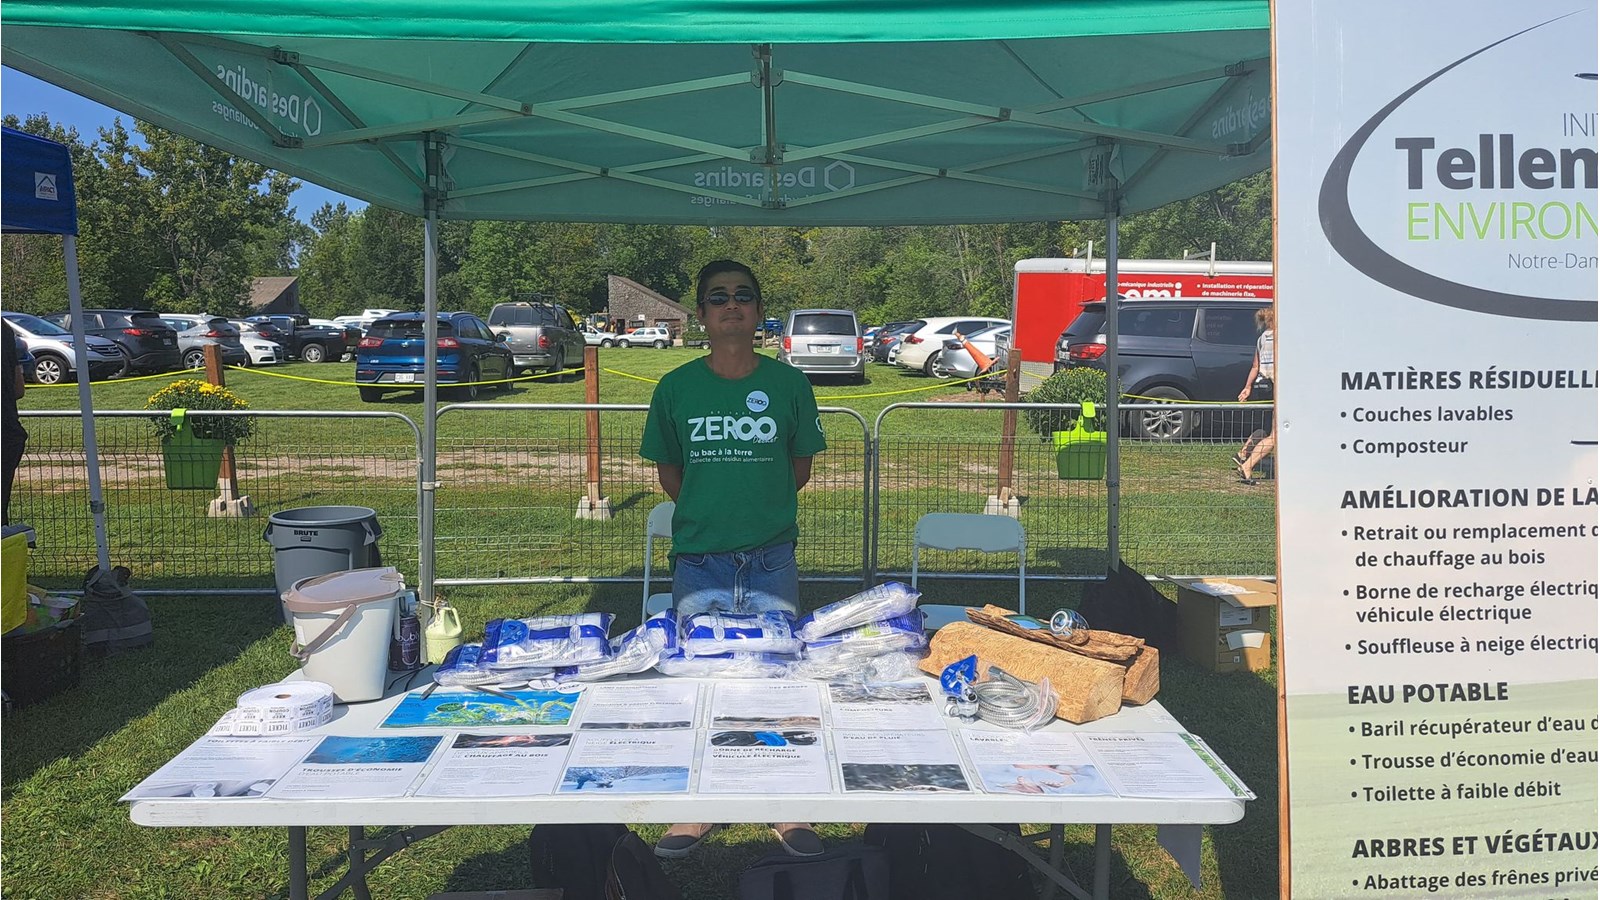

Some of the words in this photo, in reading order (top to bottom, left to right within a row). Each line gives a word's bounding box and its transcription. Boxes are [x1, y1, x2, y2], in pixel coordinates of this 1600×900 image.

[1563, 112, 1598, 137] INI
[1407, 201, 1598, 241] ENVIRON
[1341, 366, 1462, 391] MATIÈRES
[1353, 407, 1432, 422] Couches
[1437, 405, 1514, 421] lavables
[689, 450, 700, 458] Du
[718, 448, 723, 456] à
[724, 448, 732, 456] la
[734, 448, 753, 456] terre
[1353, 439, 1468, 458] Composteur
[1341, 485, 1529, 509] AMÉLIORATION
[1536, 488, 1565, 506] DE
[294, 529, 318, 537] BRUTE
[1353, 525, 1419, 541] Retrait
[1424, 527, 1448, 540] ou
[1452, 524, 1586, 543] remplacement
[1355, 551, 1378, 567] de
[1383, 550, 1476, 570] chauffage
[1481, 552, 1503, 565] au
[1508, 549, 1546, 565] bois
[1355, 584, 1411, 599] Borne
[1416, 583, 1439, 599] de
[1444, 582, 1525, 601] recharge
[1356, 606, 1434, 623] véhicule
[1439, 605, 1532, 624] électrique
[1358, 638, 1455, 655] Souffleuse
[1460, 637, 1471, 652] à
[1476, 637, 1525, 656] neige
[1347, 685, 1395, 705] EAU
[1403, 682, 1509, 704] POTABLE
[268, 724, 288, 732] TICKET
[1361, 721, 1404, 737] Baril
[1410, 718, 1532, 739] récupérateur
[1537, 716, 1585, 732] d'eau
[1362, 754, 1435, 770] Trousse
[1440, 749, 1545, 768] d'économie
[1550, 748, 1598, 764] d'eau
[1363, 786, 1435, 802] Toilette
[1441, 785, 1451, 800] à
[1456, 783, 1509, 799] faible
[1514, 781, 1561, 798] débit
[1352, 837, 1445, 858] ARBRES
[1452, 836, 1478, 855] ET
[1364, 874, 1450, 892] Abattage
[1455, 873, 1486, 889] des
[1491, 870, 1549, 886] frênes
